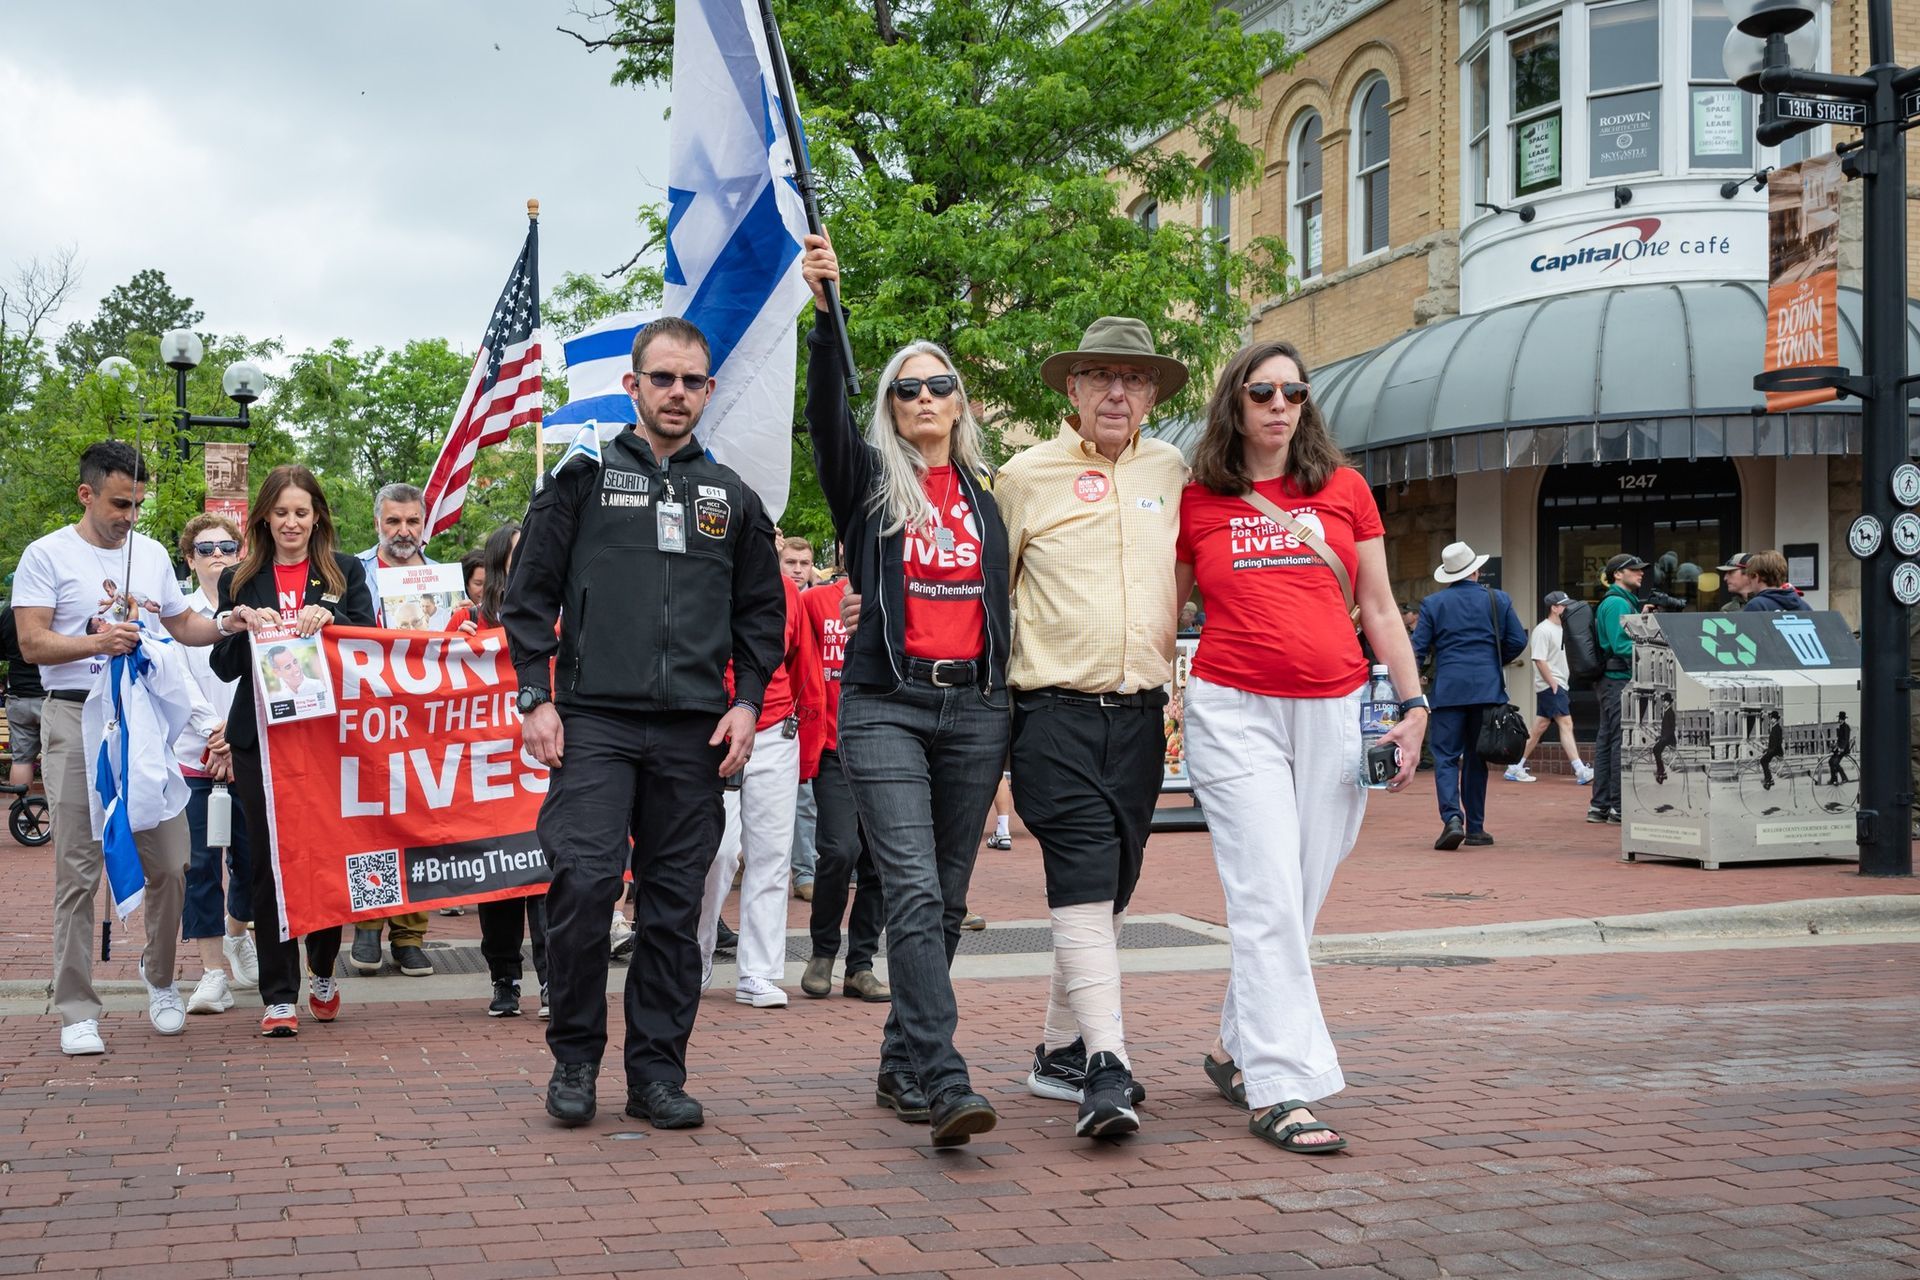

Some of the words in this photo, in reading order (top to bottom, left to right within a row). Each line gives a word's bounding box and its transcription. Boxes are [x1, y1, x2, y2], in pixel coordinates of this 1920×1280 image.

[1600, 111, 1650, 126] RODWIN
[1789, 100, 1812, 117] 13th
[1817, 103, 1855, 121] STREET
[1528, 133, 1549, 144] SPACE
[1528, 147, 1549, 158] LEASE
[1680, 236, 1731, 254] café
[1777, 296, 1823, 338] DOWN
[1776, 328, 1824, 368] TOWN
[605, 471, 648, 491] SECURITY
[1617, 474, 1658, 489] 1247
[601, 493, 608, 507] S.
[608, 495, 649, 507] AMMERMAN
[1231, 528, 1252, 539] FOR
[1232, 533, 1300, 554] LIVES
[903, 538, 977, 568] IVES
[909, 582, 983, 597] #BringThemHom
[257, 628, 297, 640] KIDNAPP
[824, 619, 847, 634] RU
[824, 635, 837, 644] FOR
[823, 645, 845, 661] LIV
[337, 636, 501, 700] RUN
[339, 704, 409, 744] FOR
[424, 691, 524, 735] THEIR
[341, 739, 551, 819] LIVES
[412, 848, 547, 884] #BringThem
